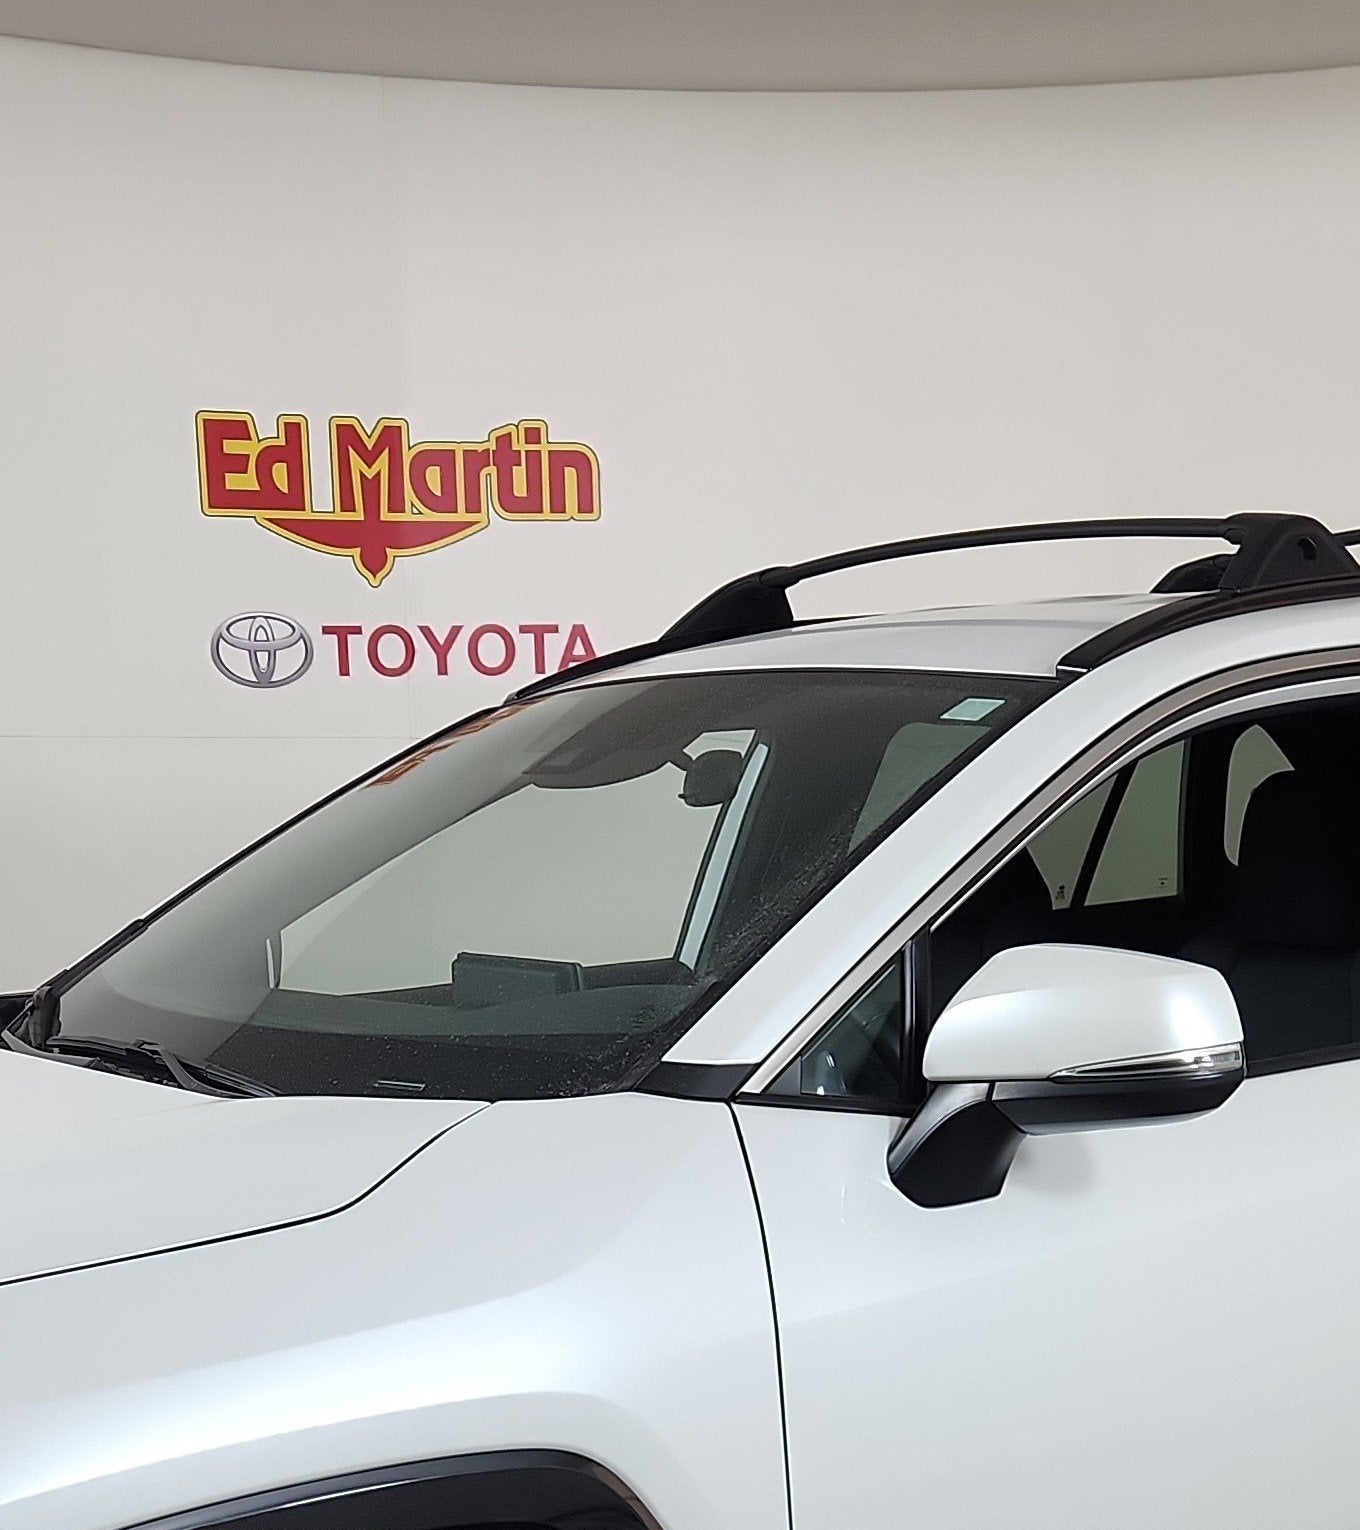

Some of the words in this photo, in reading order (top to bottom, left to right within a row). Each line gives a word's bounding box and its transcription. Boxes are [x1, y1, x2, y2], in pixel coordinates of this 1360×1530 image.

[195, 410, 309, 518] Ed
[328, 417, 601, 522] Martin
[320, 622, 599, 678] TOYOTA
